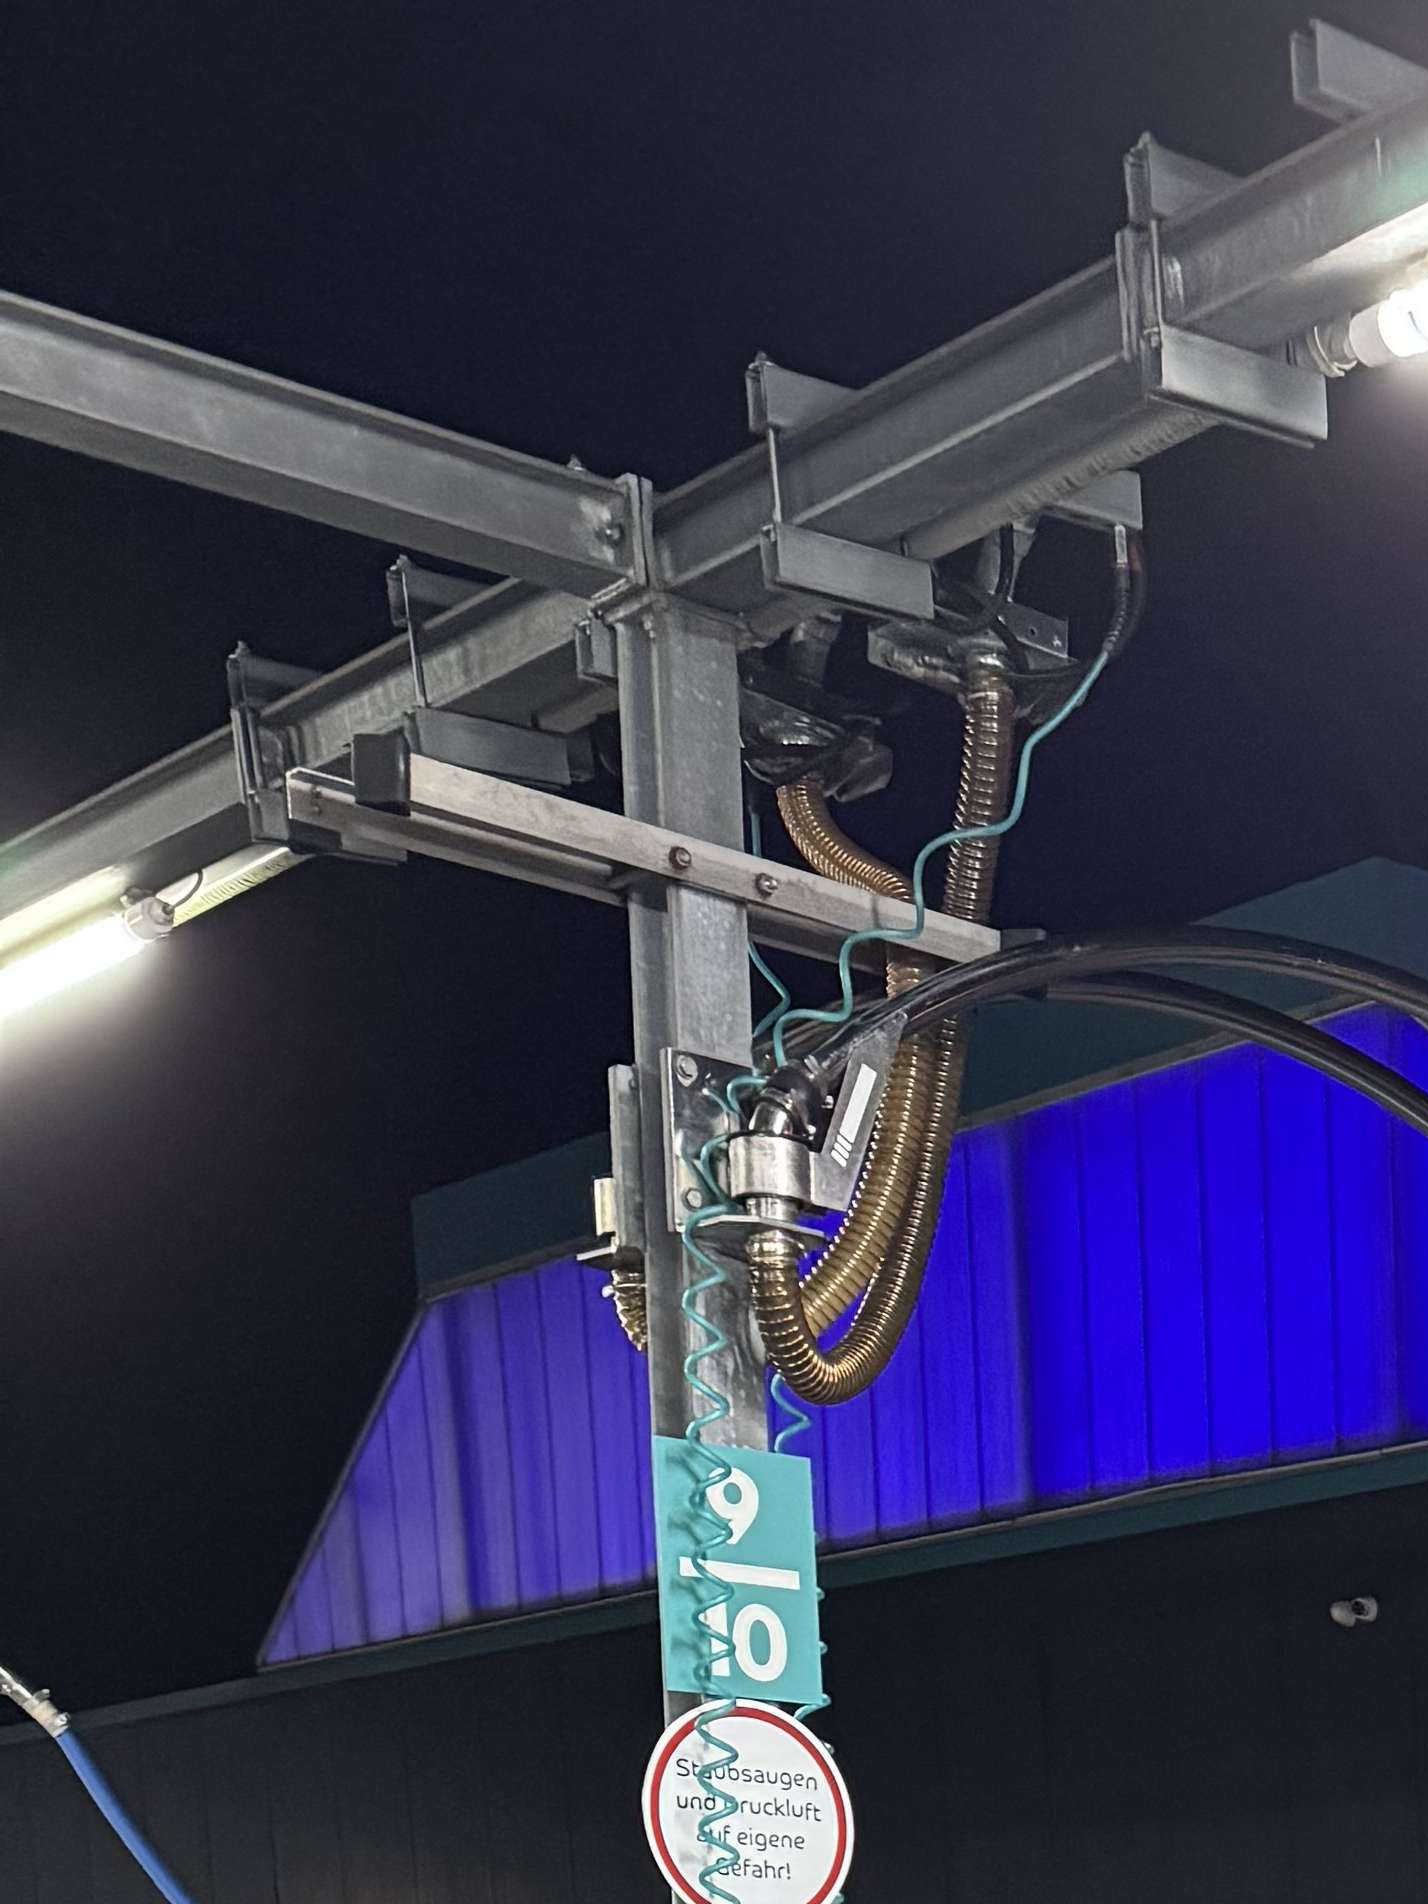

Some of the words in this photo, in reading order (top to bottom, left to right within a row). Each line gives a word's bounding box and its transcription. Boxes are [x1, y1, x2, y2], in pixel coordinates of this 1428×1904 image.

[705, 1466, 760, 1545] 9
[698, 1600, 788, 1683] 10
[676, 1789, 717, 1811] und
[724, 1796, 823, 1823] ruckluft
[736, 1827, 806, 1852] eigene
